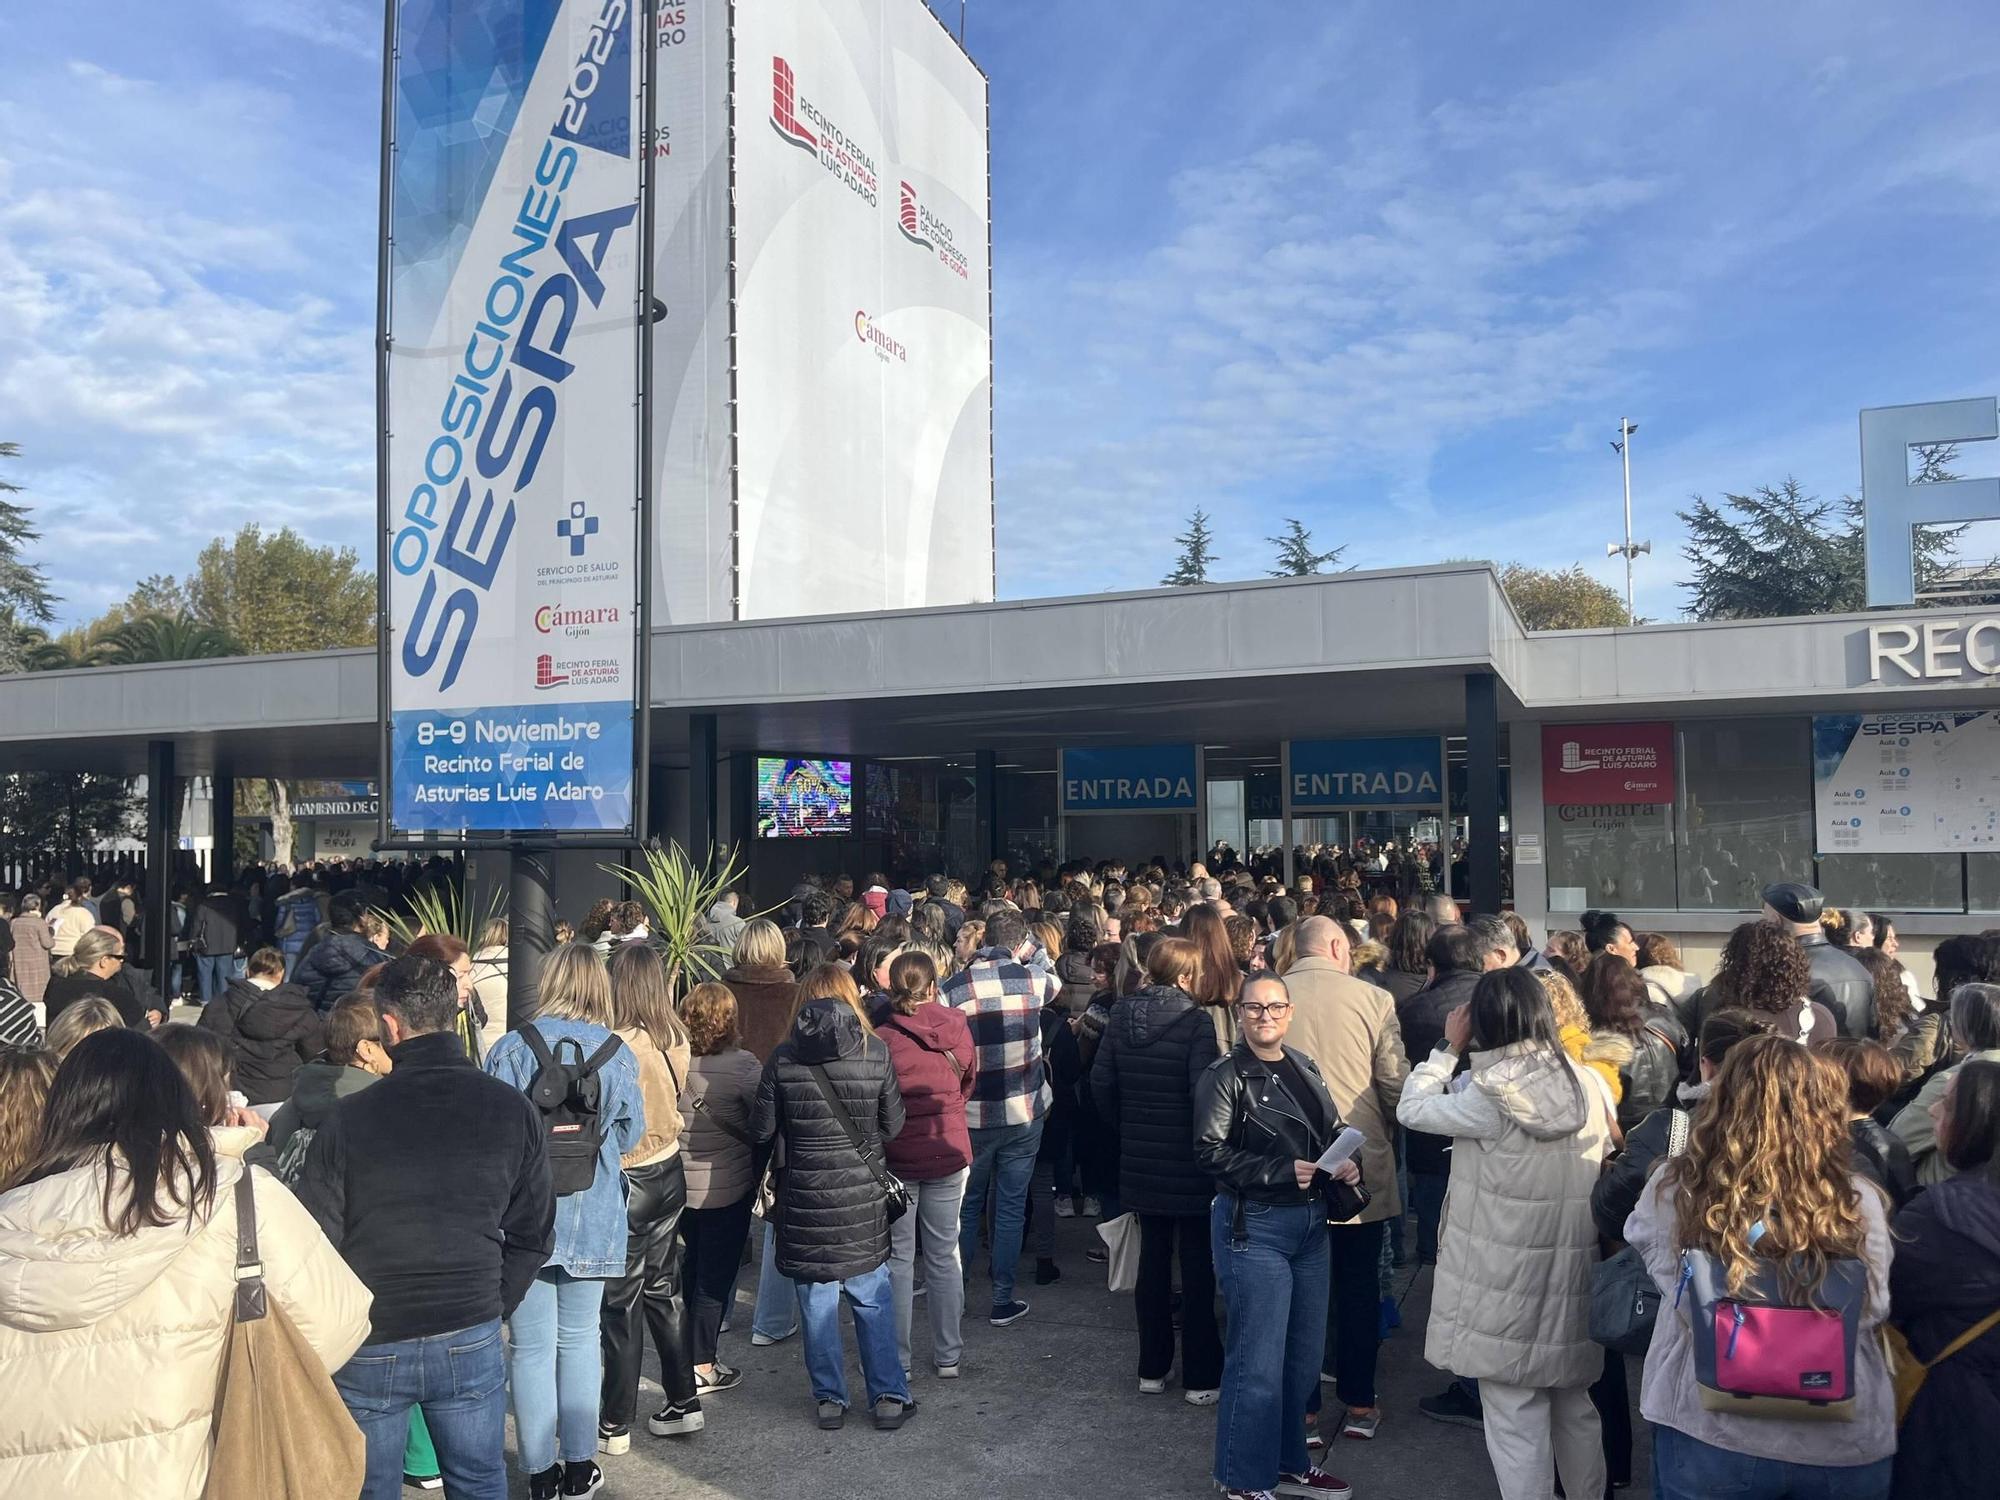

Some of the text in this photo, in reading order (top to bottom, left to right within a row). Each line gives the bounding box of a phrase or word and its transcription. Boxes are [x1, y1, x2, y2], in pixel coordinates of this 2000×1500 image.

[556, 0, 627, 134] 2025
[801, 96, 877, 177] RECINTO FERIAL
[821, 134, 877, 192] DE ASTURIAS
[821, 150, 877, 208] LUIS ADARO
[920, 205, 952, 242] PALACIO
[920, 220, 968, 268] DE CONGRESOS
[939, 250, 949, 265] DE
[855, 310, 906, 363] Cámara
[393, 138, 578, 576] OPOSICIONES
[401, 203, 639, 693] SESPA
[537, 562, 619, 577] SERVICIO DE SALUD
[535, 603, 619, 634] Cámara
[565, 625, 590, 639] Gijón
[556, 659, 619, 670] RECINTO FERIAL
[571, 667, 619, 677] DE ASTURIAS
[571, 676, 619, 685] LUIS ADARO
[475, 716, 601, 744] Noviembre
[1862, 721, 1949, 735] SESPA
[424, 751, 585, 774] Recinto Ferial de
[1584, 747, 1656, 756] RECINTO FERIAL
[414, 781, 604, 803] Asturias Luis Adaro
[1066, 777, 1193, 801] ENTRADA
[1294, 771, 1438, 796] ENTRADA
[288, 802, 349, 816] NTAMIENTO
[353, 801, 368, 814] DE
